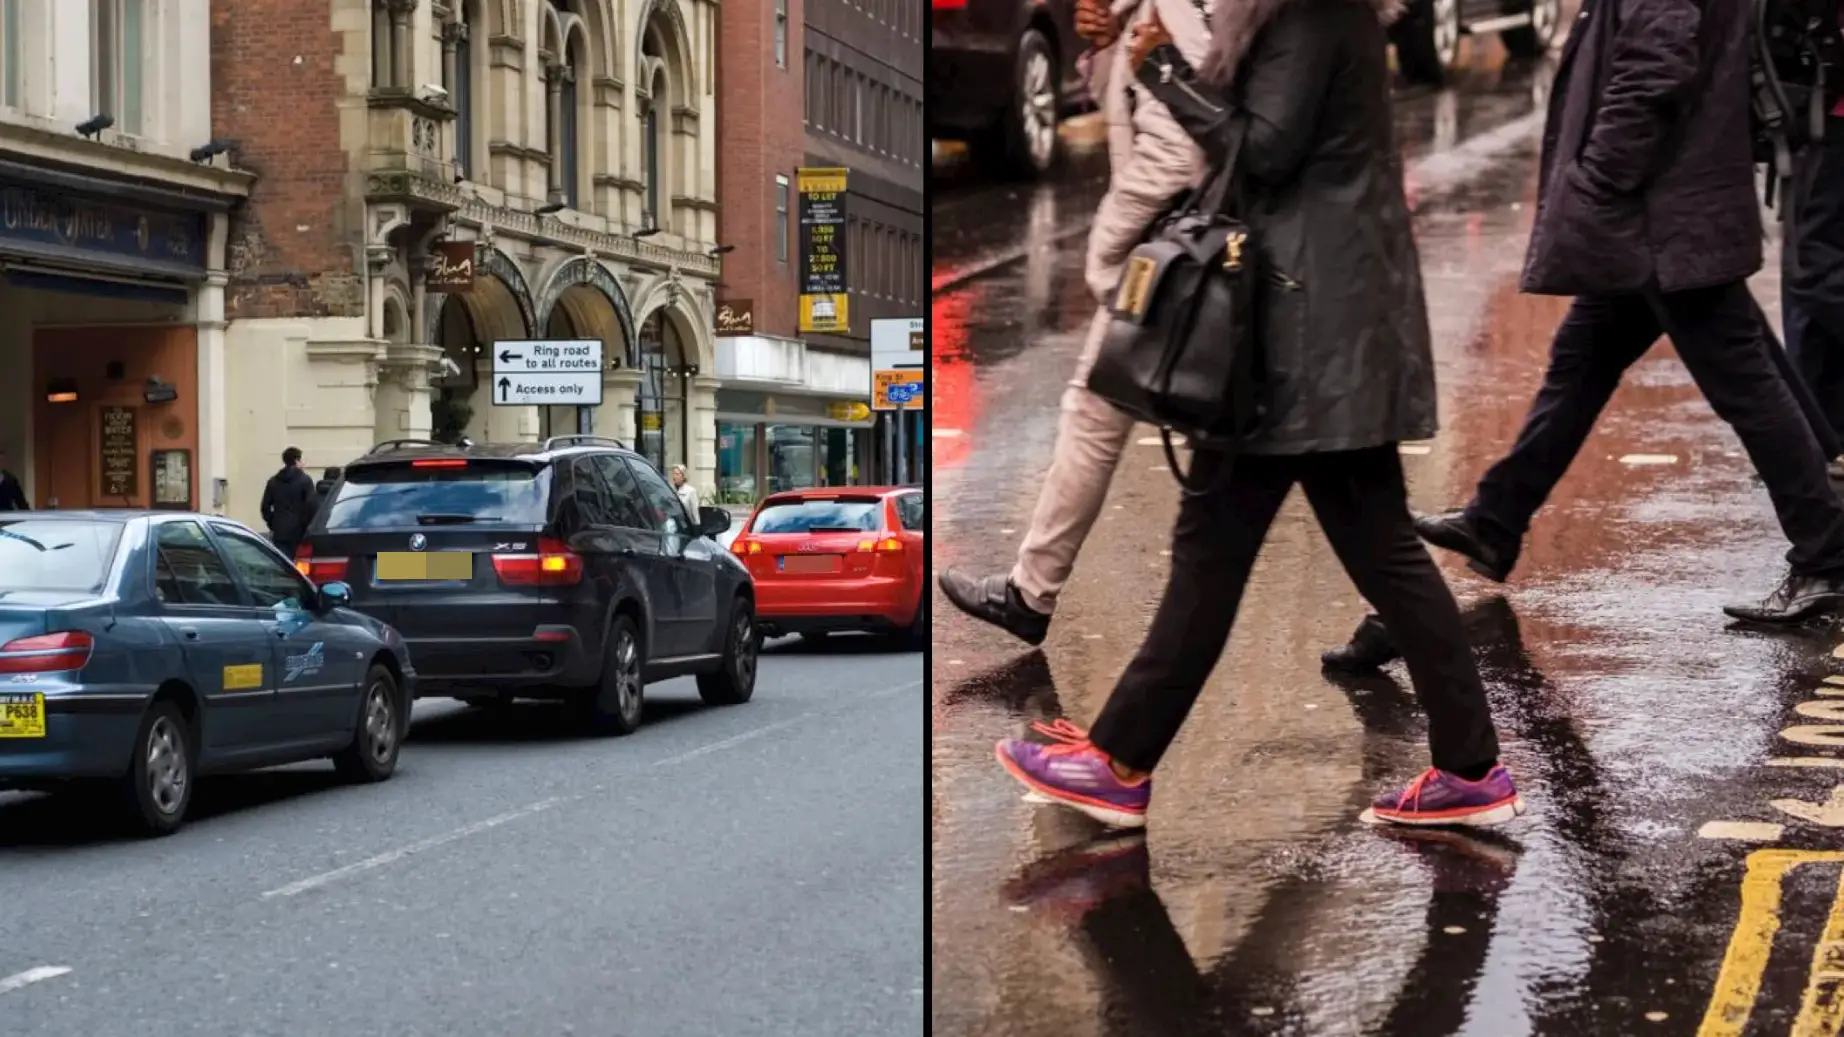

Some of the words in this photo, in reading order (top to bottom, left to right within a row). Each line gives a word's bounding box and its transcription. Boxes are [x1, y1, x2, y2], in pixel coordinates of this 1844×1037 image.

[718, 308, 752, 325] Slug
[533, 345, 559, 357] Ring
[563, 345, 590, 355] road
[526, 359, 537, 368] to
[541, 358, 556, 368] all
[559, 359, 598, 368] routes
[515, 384, 556, 394] Access
[559, 383, 584, 396] only
[6, 705, 37, 719] P638
